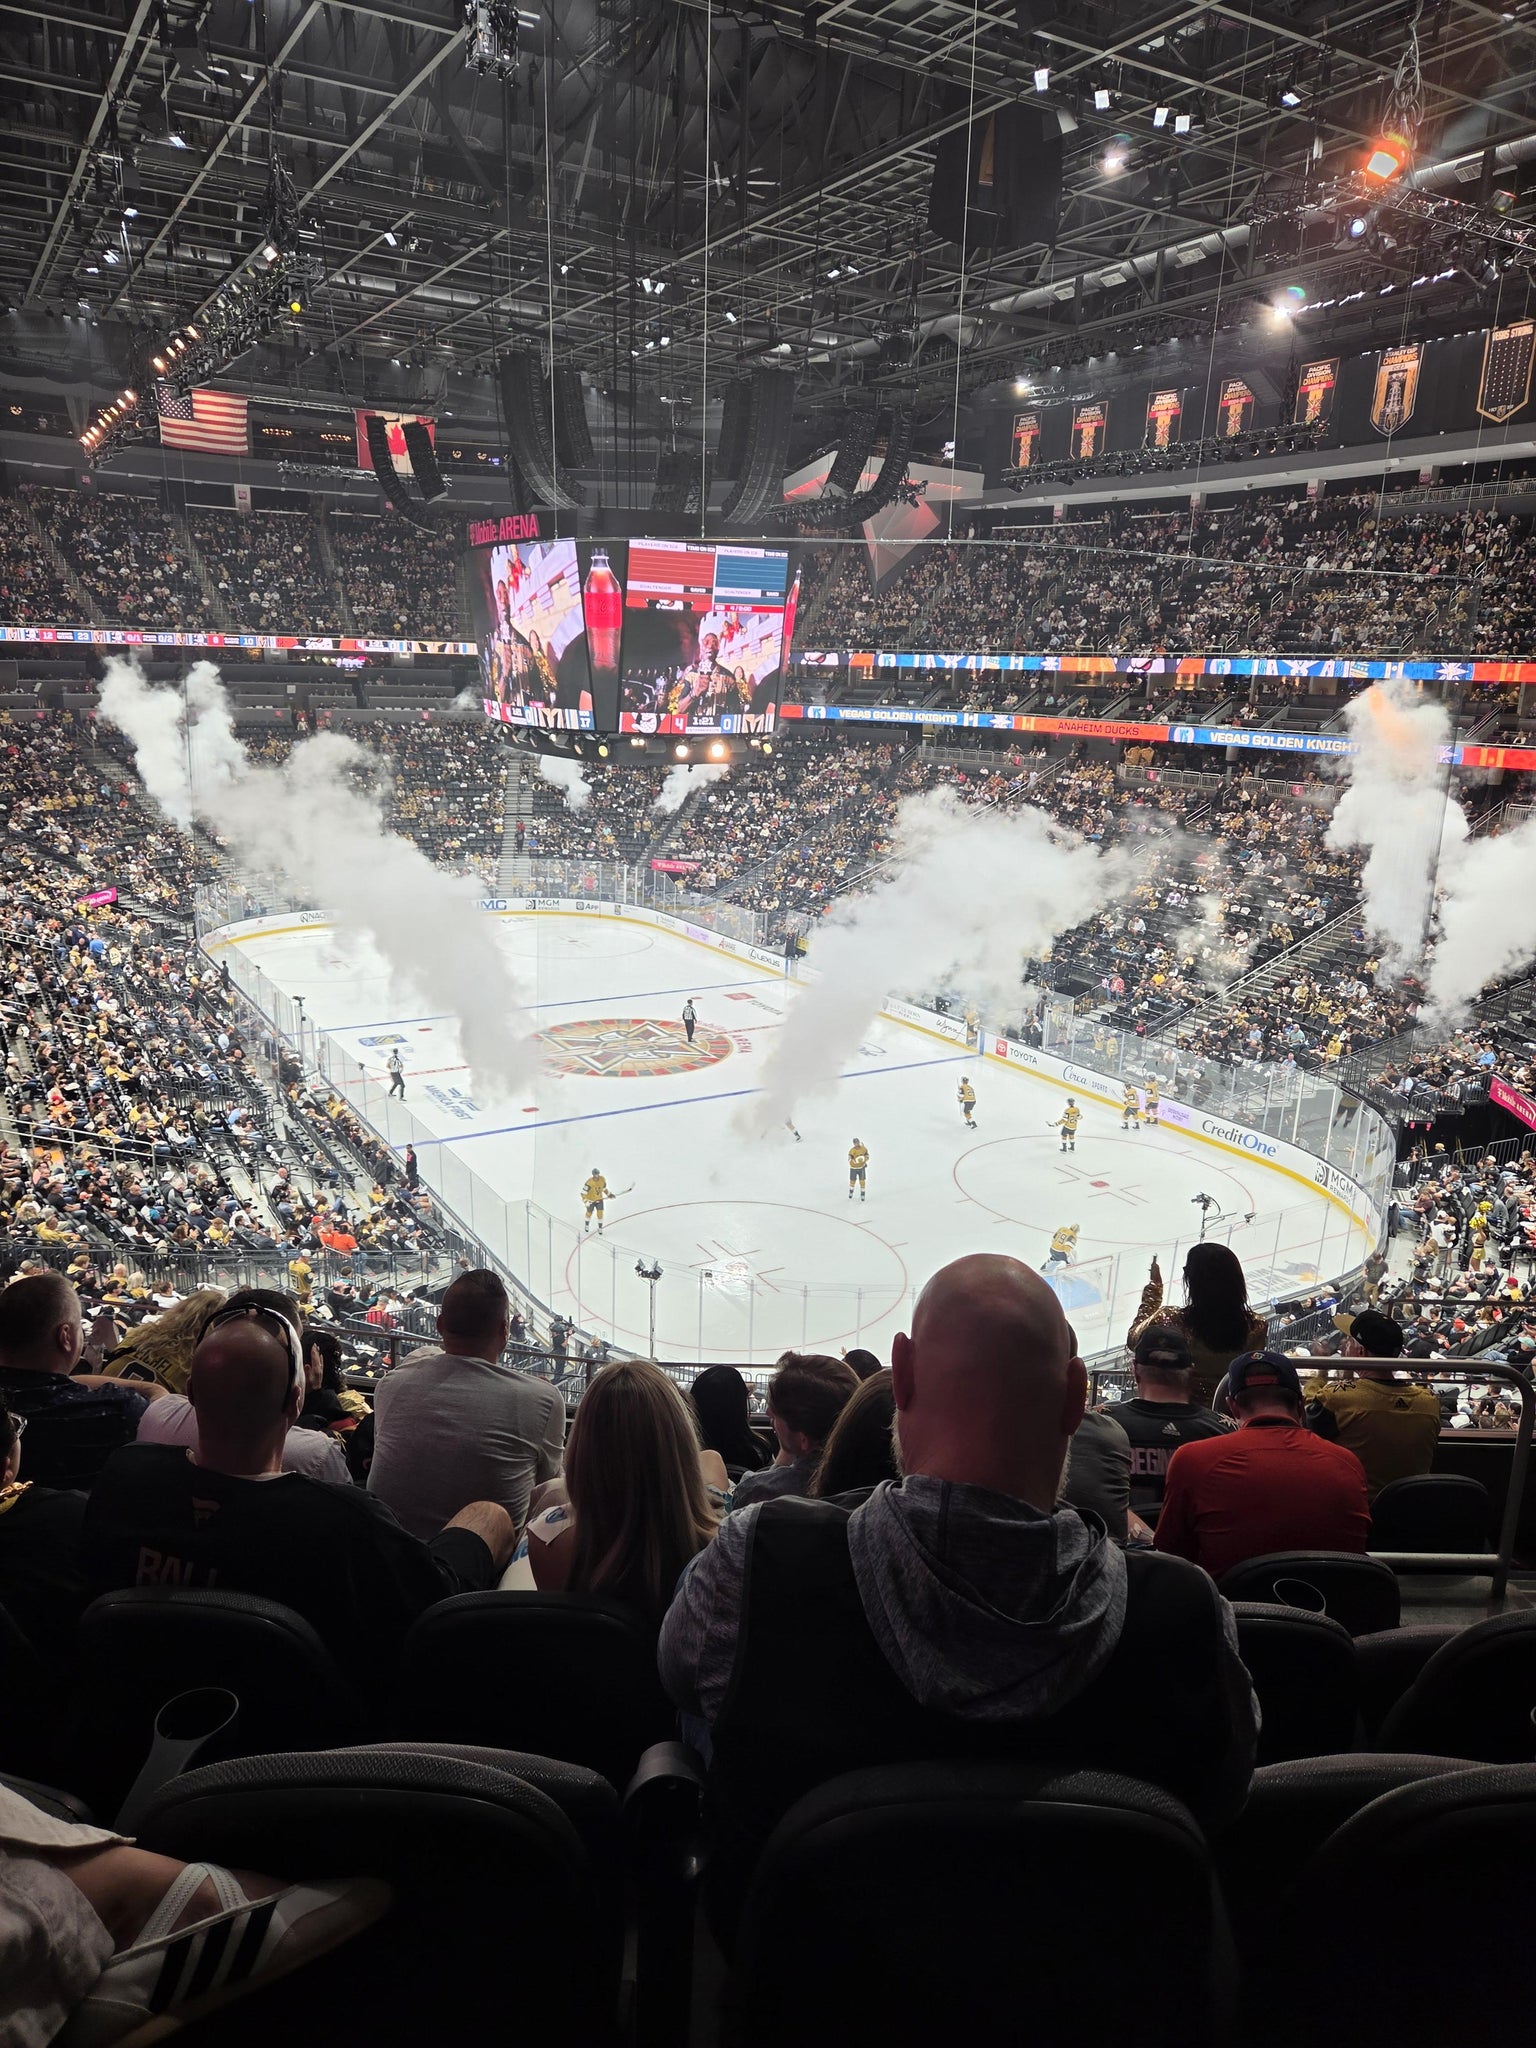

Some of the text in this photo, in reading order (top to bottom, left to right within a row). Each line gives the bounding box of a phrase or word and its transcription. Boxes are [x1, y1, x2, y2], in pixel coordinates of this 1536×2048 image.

[1382, 353, 1418, 365] CHAMPIONS
[1303, 373, 1334, 386] CHAMPIONS
[499, 513, 539, 541] ARENA
[42, 631, 54, 640] 12
[77, 632, 89, 640] 23
[243, 636, 253, 645] 10
[580, 717, 591, 728] 17
[692, 716, 714, 726] 1:21
[838, 709, 958, 723] VEGAS GOLDEN KNIGHTS
[675, 717, 684, 731] 4
[723, 718, 732, 731] 0
[1058, 721, 1140, 736] ANAHEIM DUCKS
[1209, 732, 1250, 743] VEGAS
[1252, 735, 1304, 749] GOLDEN
[756, 953, 781, 968] LEXUS
[1010, 1048, 1038, 1065] TOYOTA
[1062, 1064, 1108, 1094] Circa SPORTS
[450, 1104, 475, 1120] FIRST
[1331, 1171, 1353, 1193] MGM
